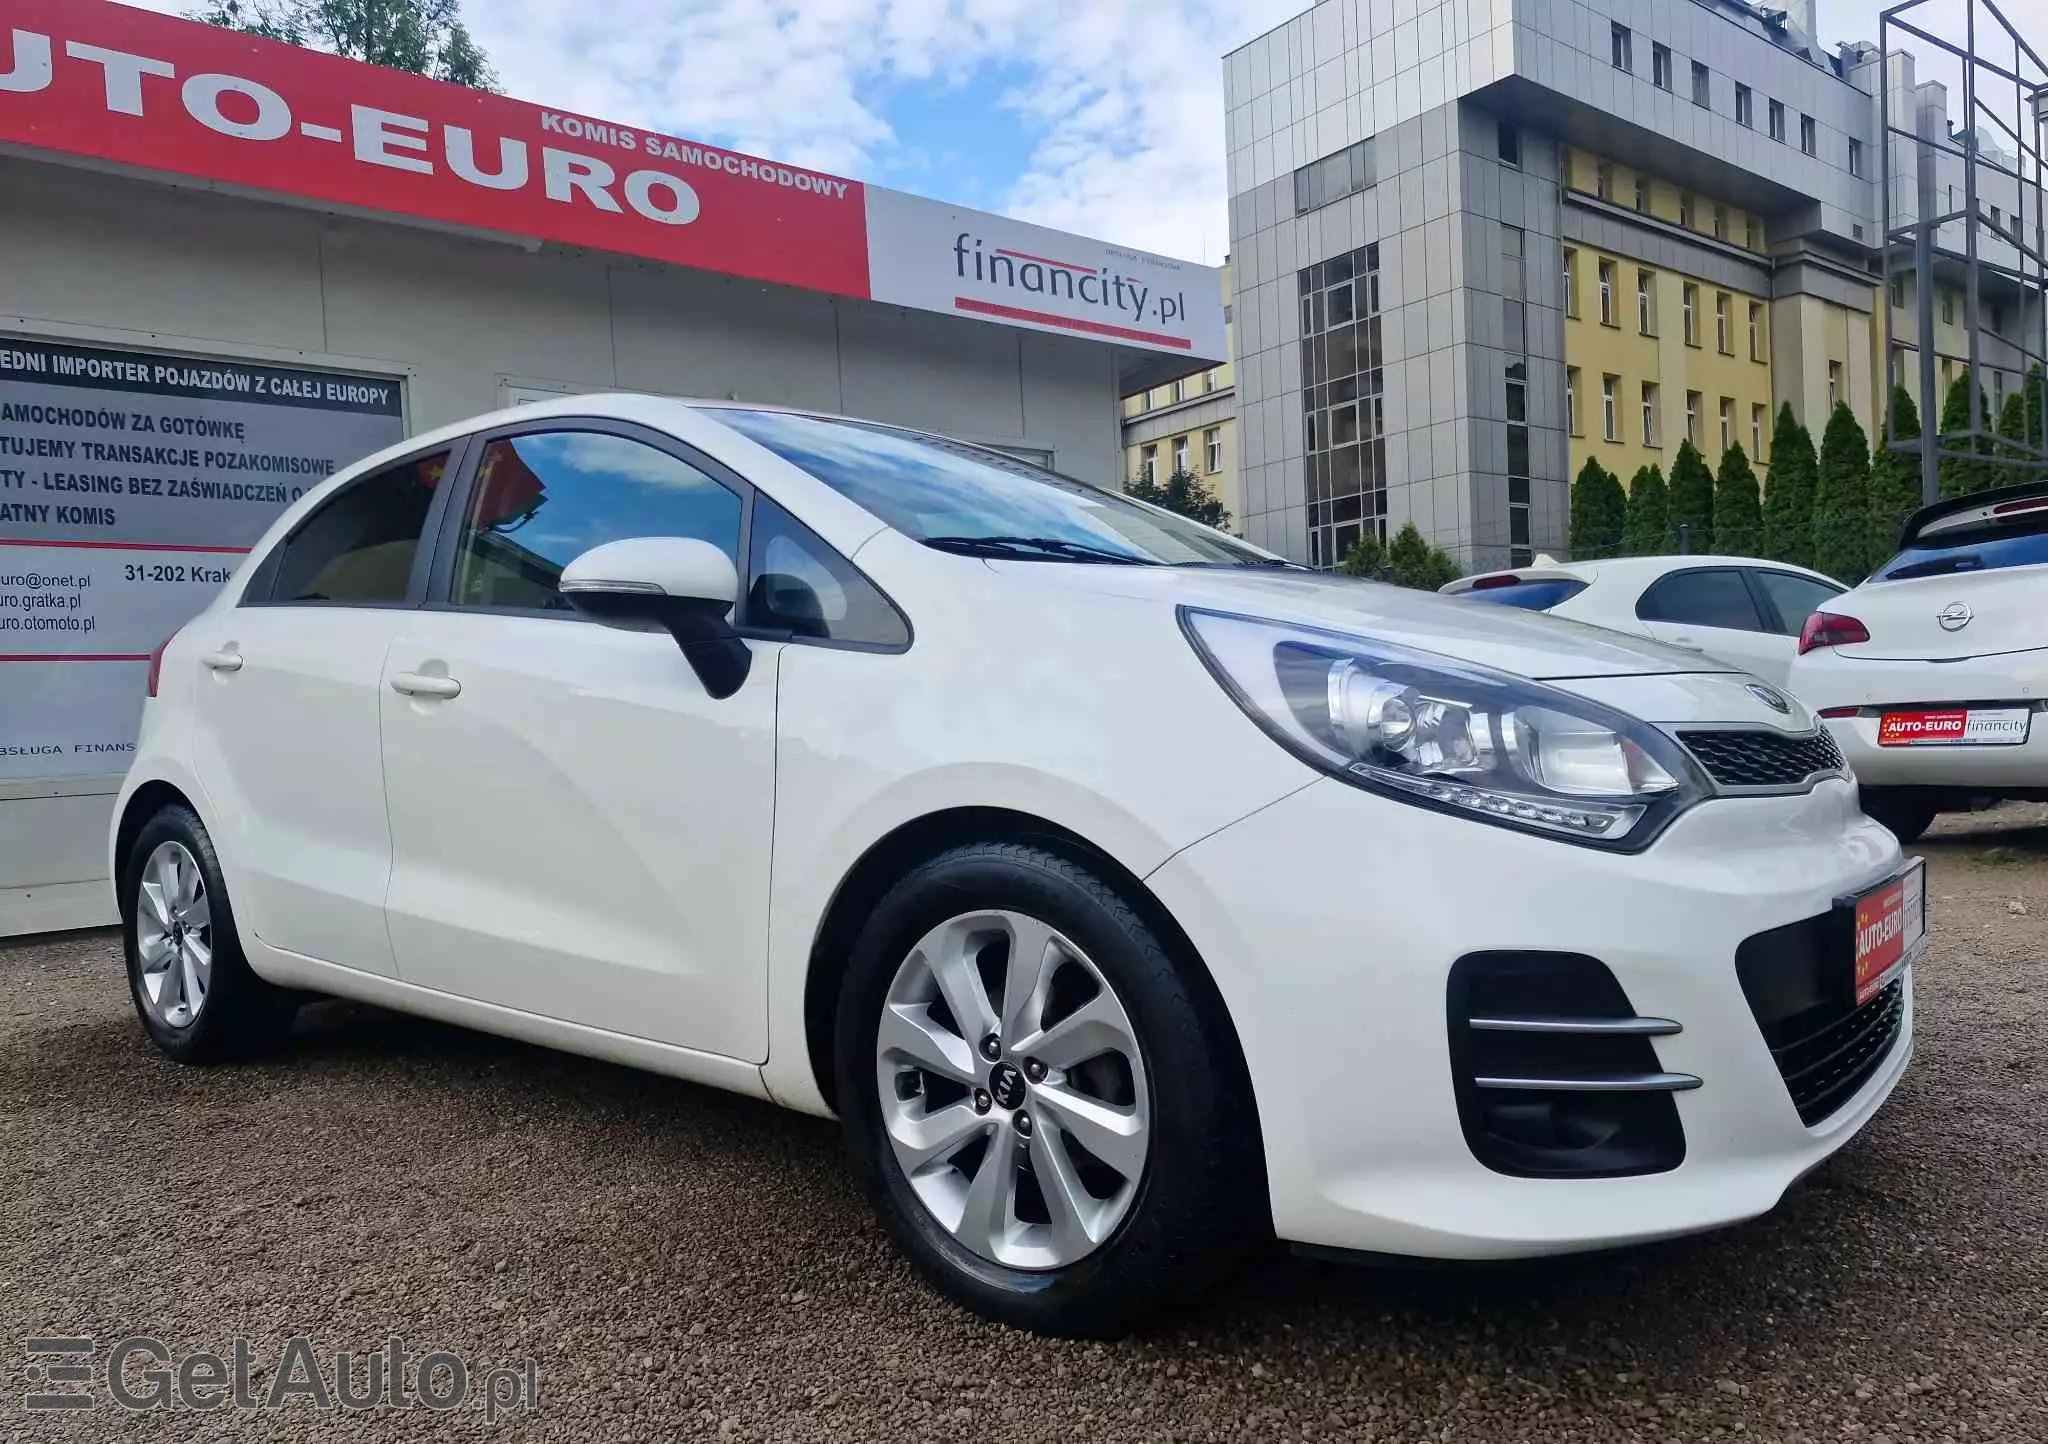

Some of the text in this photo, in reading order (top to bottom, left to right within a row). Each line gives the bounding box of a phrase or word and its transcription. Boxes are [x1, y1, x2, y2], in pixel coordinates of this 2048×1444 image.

[541, 111, 849, 200] KOMIS SAMOCHODOWY
[953, 232, 1186, 325] financity.pl
[0, 350, 389, 405] EDNI IMPORTER POJAZDÓW Z CAŁEJ EUROPY
[2, 403, 246, 444] AMOCHODÓW ZA GOTÓWKĘ
[0, 436, 335, 476] TUJEMY TRANSAKCJE POZAKOMISOWE
[0, 469, 25, 489] TY
[43, 472, 123, 494] LEASING
[128, 477, 163, 496] BEZ
[167, 477, 287, 502] ZAŚWIADCZEŃ
[0, 503, 116, 526] ATNY KOMIS
[1, 573, 91, 590] uro@onet.pl
[124, 564, 186, 582] 31-202
[1887, 720, 1962, 733] AUTO-EURO
[74, 742, 137, 753] FINANS
[1859, 908, 1902, 958] AUTO-EURO
